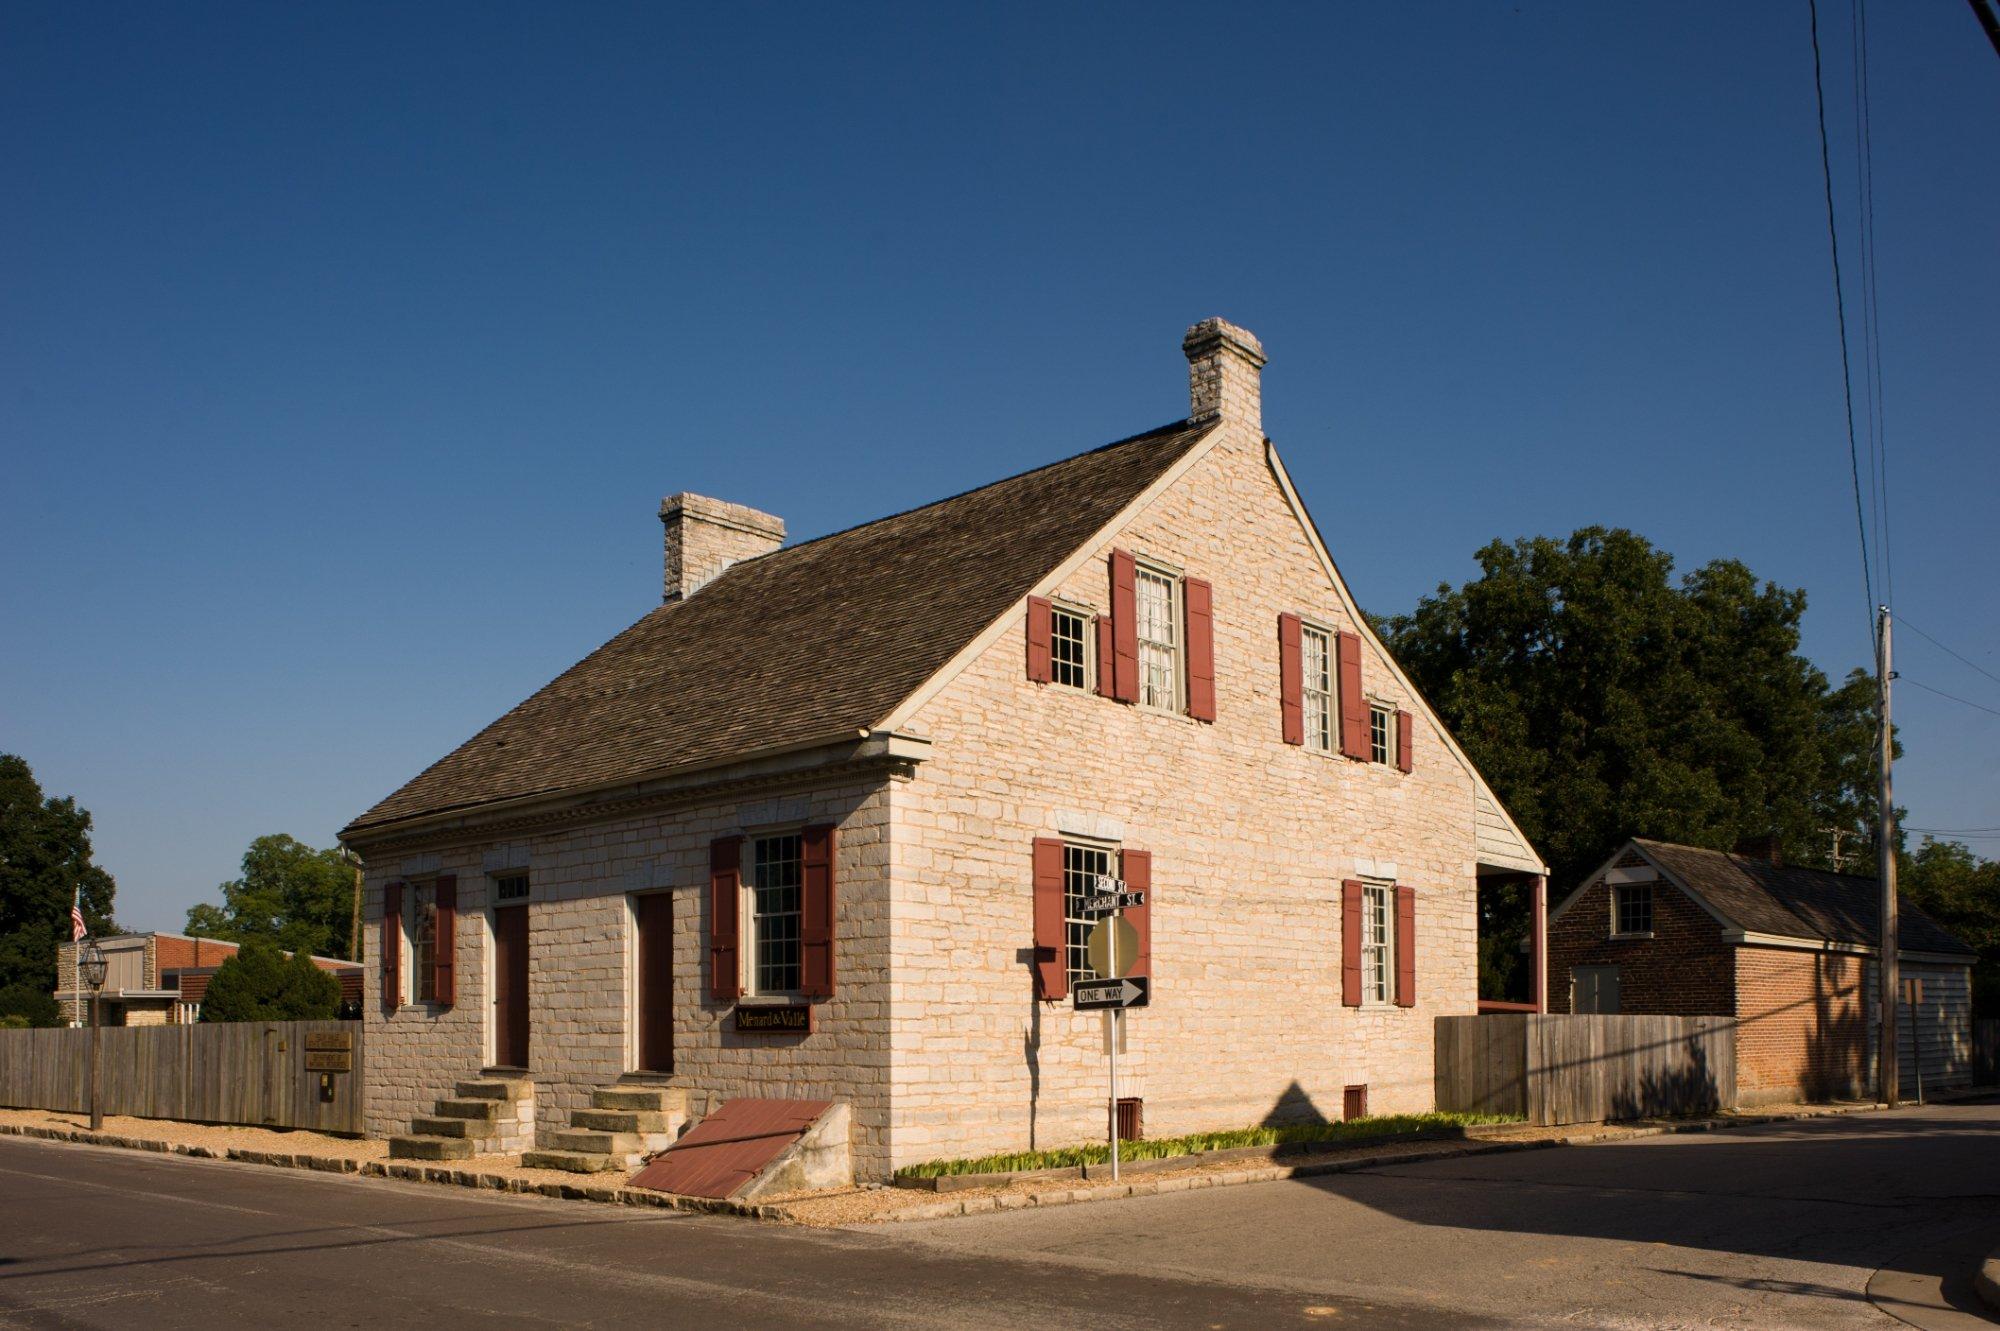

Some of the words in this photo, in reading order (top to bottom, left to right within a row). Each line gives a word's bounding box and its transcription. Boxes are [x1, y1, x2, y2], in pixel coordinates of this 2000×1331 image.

[1083, 895, 1120, 909] MERCHANT
[1126, 894, 1137, 906] ST.
[1080, 989, 1099, 1001] ONE
[1104, 987, 1123, 1000] WAY
[738, 1011, 772, 1027] Menard
[773, 1013, 781, 1025] &
